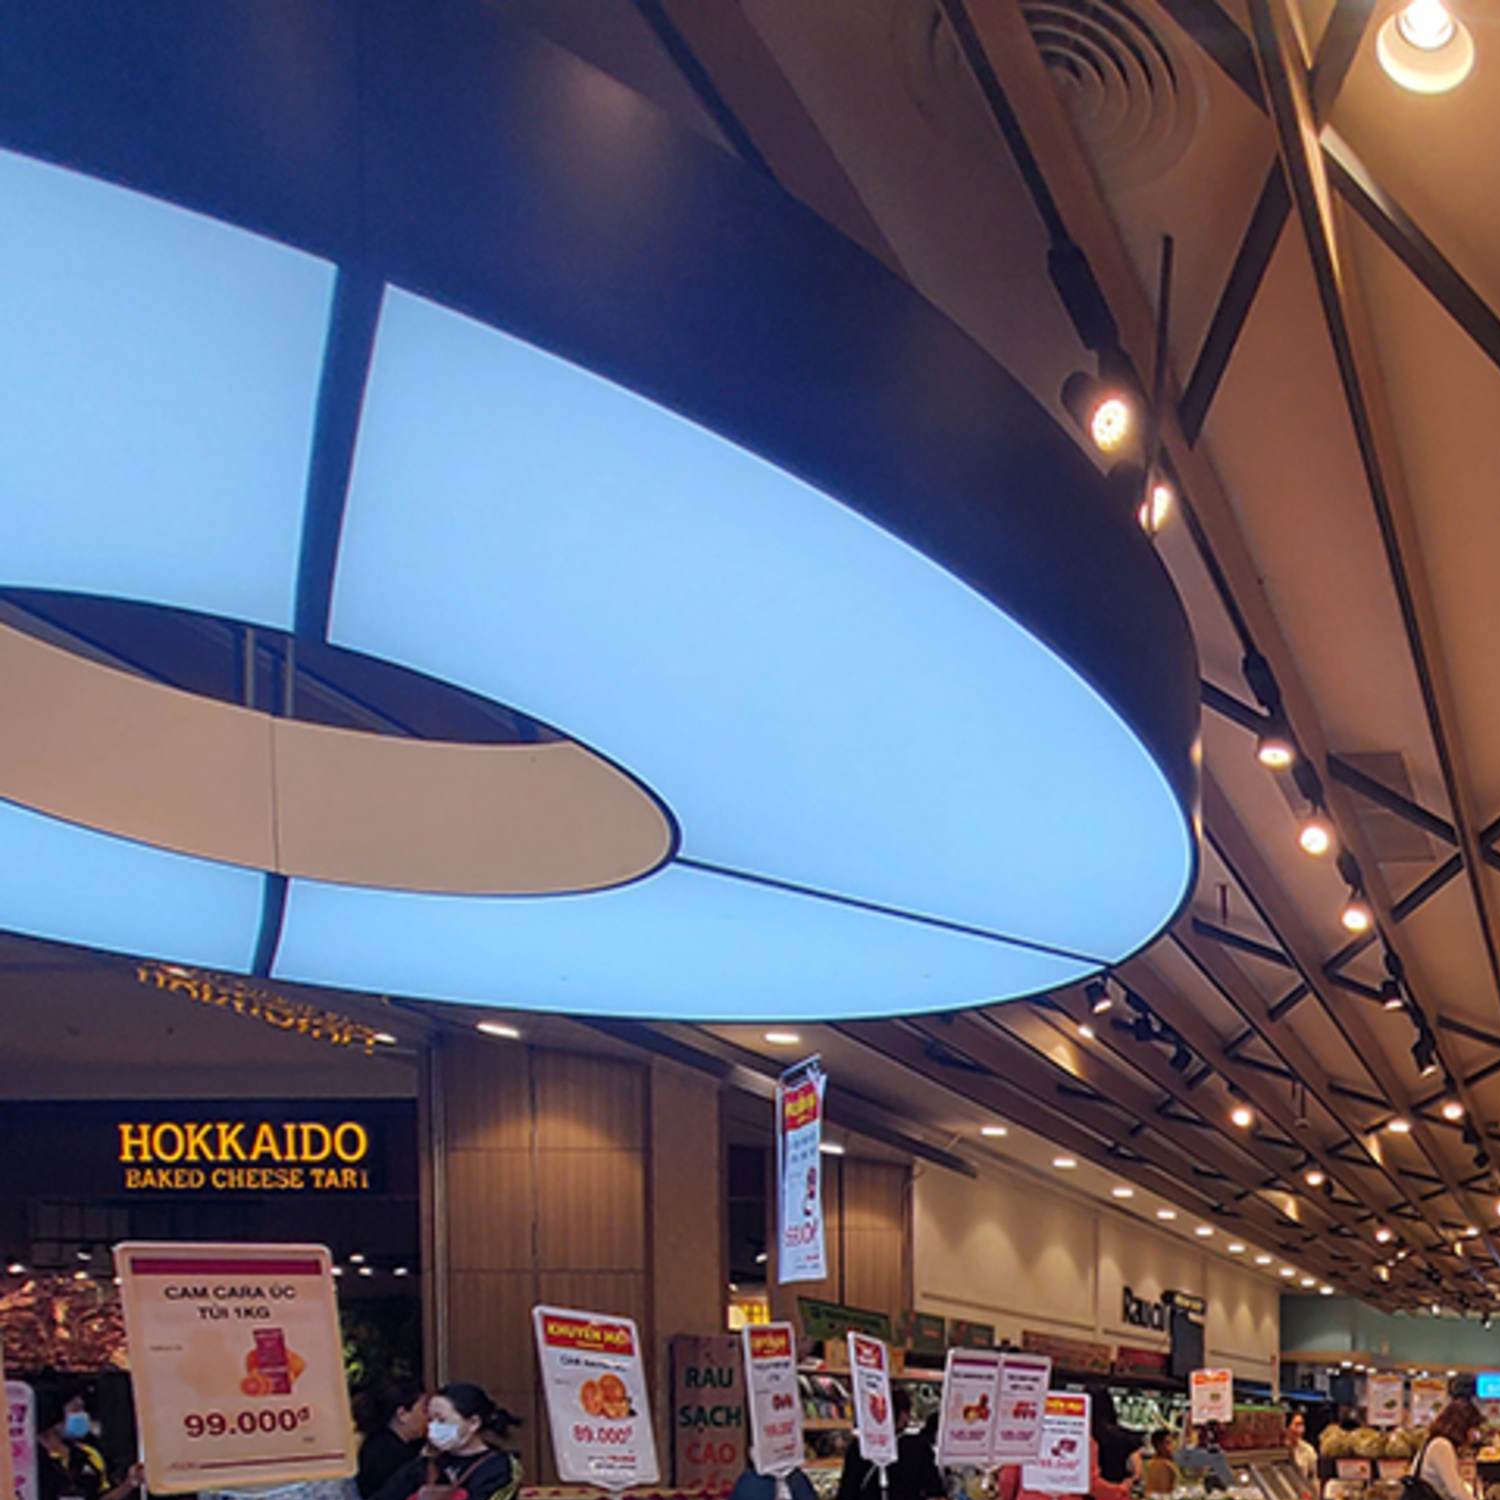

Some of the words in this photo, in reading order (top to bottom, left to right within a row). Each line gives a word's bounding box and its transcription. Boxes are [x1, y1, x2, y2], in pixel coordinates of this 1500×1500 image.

[118, 1122, 368, 1162] HOKKAIDO
[126, 1168, 205, 1189] BAKED
[211, 1168, 304, 1189] CHEESE
[164, 1285, 209, 1300] CAM
[212, 1285, 265, 1300] CARA
[269, 1280, 296, 1300] ÚC
[234, 1305, 271, 1320] 1KG
[684, 1366, 734, 1388] RAU
[678, 1404, 742, 1433] SẠCH
[684, 1441, 737, 1465] CAO
